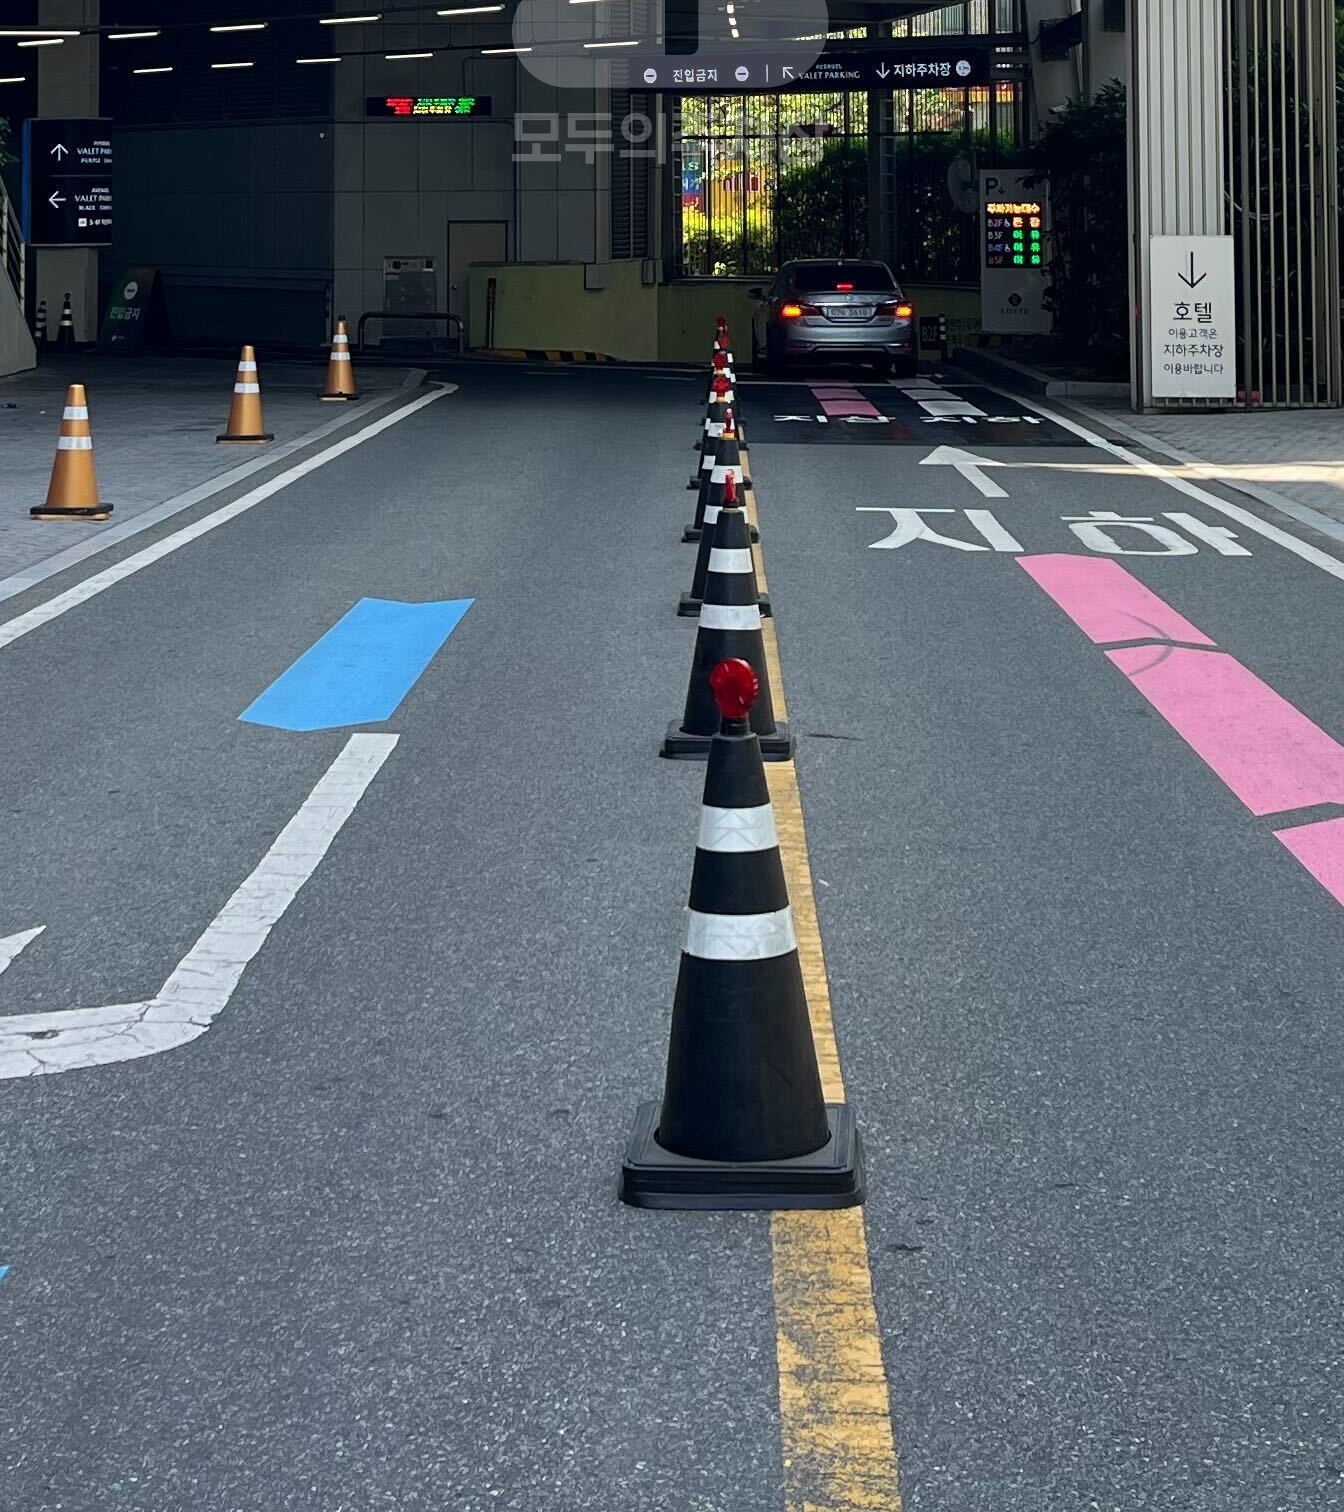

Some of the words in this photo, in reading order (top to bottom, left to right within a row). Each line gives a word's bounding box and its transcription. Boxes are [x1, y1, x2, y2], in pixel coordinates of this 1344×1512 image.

[672, 68, 718, 83] 진입금지
[798, 71, 823, 80] VALET
[824, 70, 861, 79] PARKING
[893, 62, 952, 77] 지하주차장
[985, 177, 999, 196] P
[1172, 301, 1213, 324] 호텔
[1168, 327, 1218, 340] 이용고객은
[1163, 344, 1224, 358] 지하주차장
[1163, 363, 1224, 375] 이용바랍니다
[855, 507, 1253, 557] 지하
